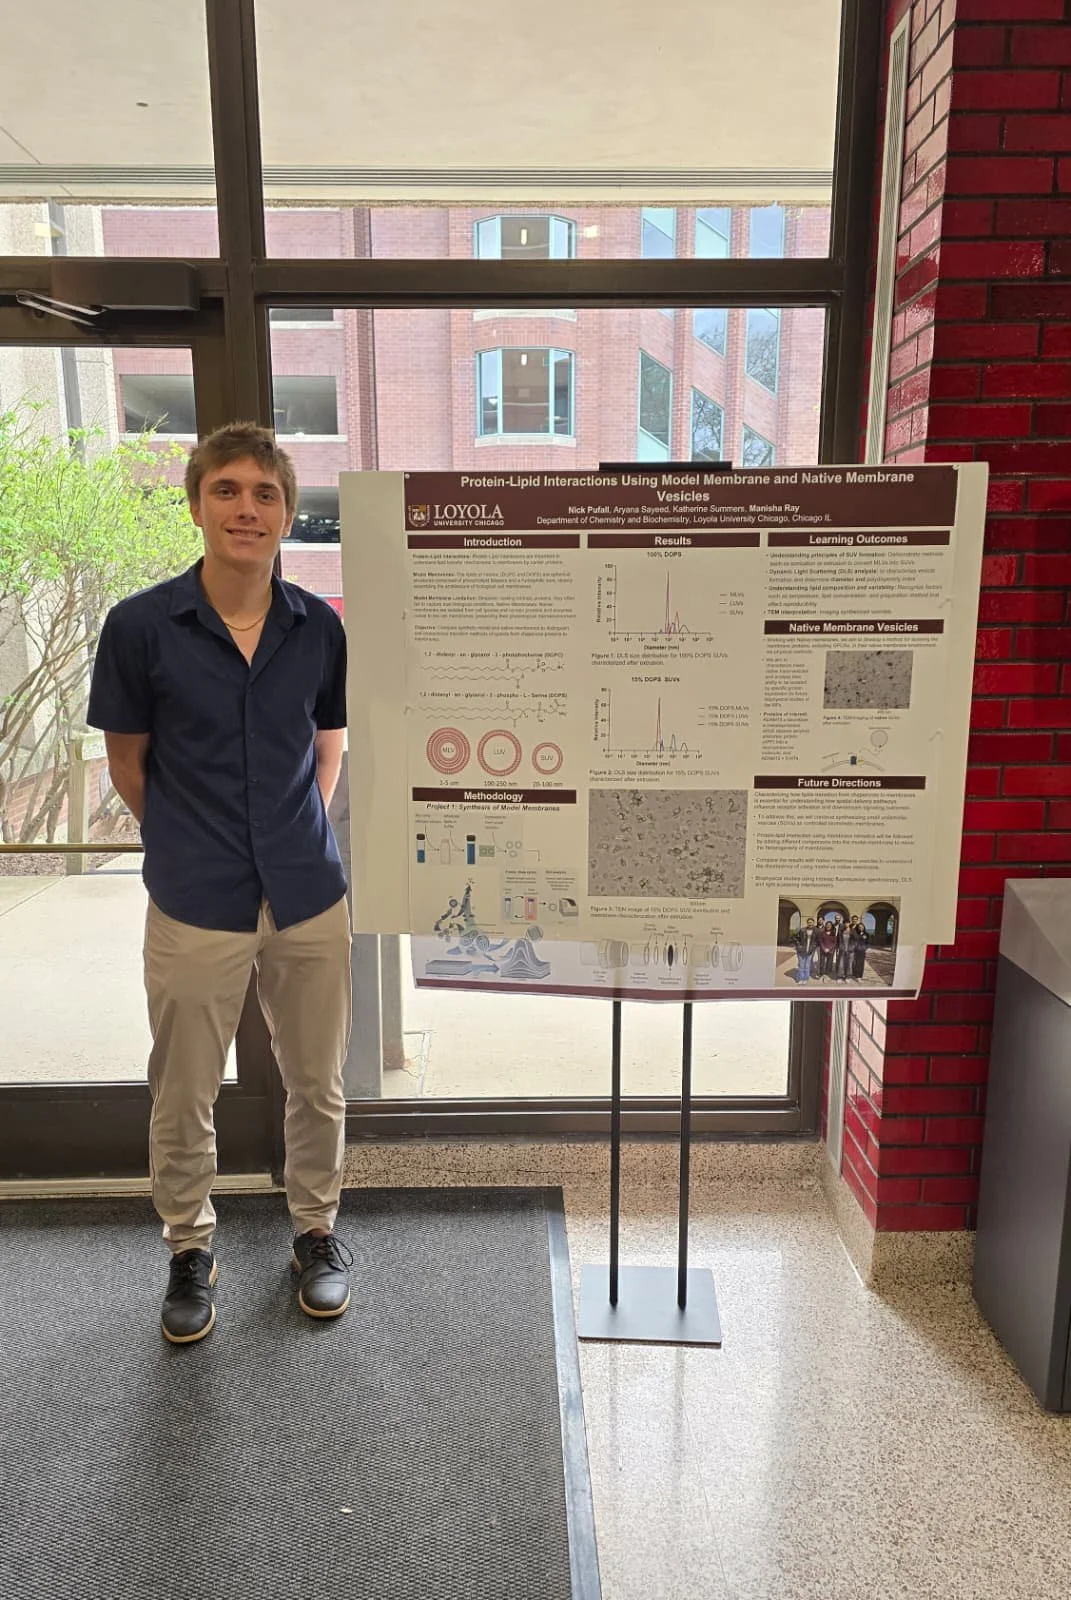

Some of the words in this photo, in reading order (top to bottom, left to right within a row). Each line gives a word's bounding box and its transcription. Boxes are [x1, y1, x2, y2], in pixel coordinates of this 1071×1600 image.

[461, 476, 540, 489] Protein-Lipid
[544, 475, 618, 487] Interactions
[622, 475, 657, 488] Using
[662, 474, 700, 485] Model
[704, 474, 770, 485] Membrane
[773, 473, 797, 484] and
[801, 473, 842, 484] Native
[846, 472, 914, 483] Membrane
[657, 491, 710, 502] Vesicles
[434, 504, 504, 519] LOYOLA
[613, 506, 639, 515] Aryana
[673, 504, 708, 513] Katherine
[749, 504, 782, 512] Manisha
[785, 504, 800, 514] Ray
[537, 516, 578, 525] Department
[589, 516, 625, 525] Chemistry
[693, 515, 718, 524] Loyola
[720, 514, 755, 523] University
[792, 514, 822, 522] Chicago
[464, 537, 521, 546] Introduction
[655, 536, 691, 545] Results
[809, 535, 853, 545] Learning
[857, 534, 908, 543] Outcomes
[789, 623, 820, 632] Native
[823, 623, 874, 632] Membrane
[877, 623, 918, 631] Vesicles
[798, 779, 829, 787] Future
[832, 779, 881, 787] Directions
[464, 792, 523, 802] Methodology
